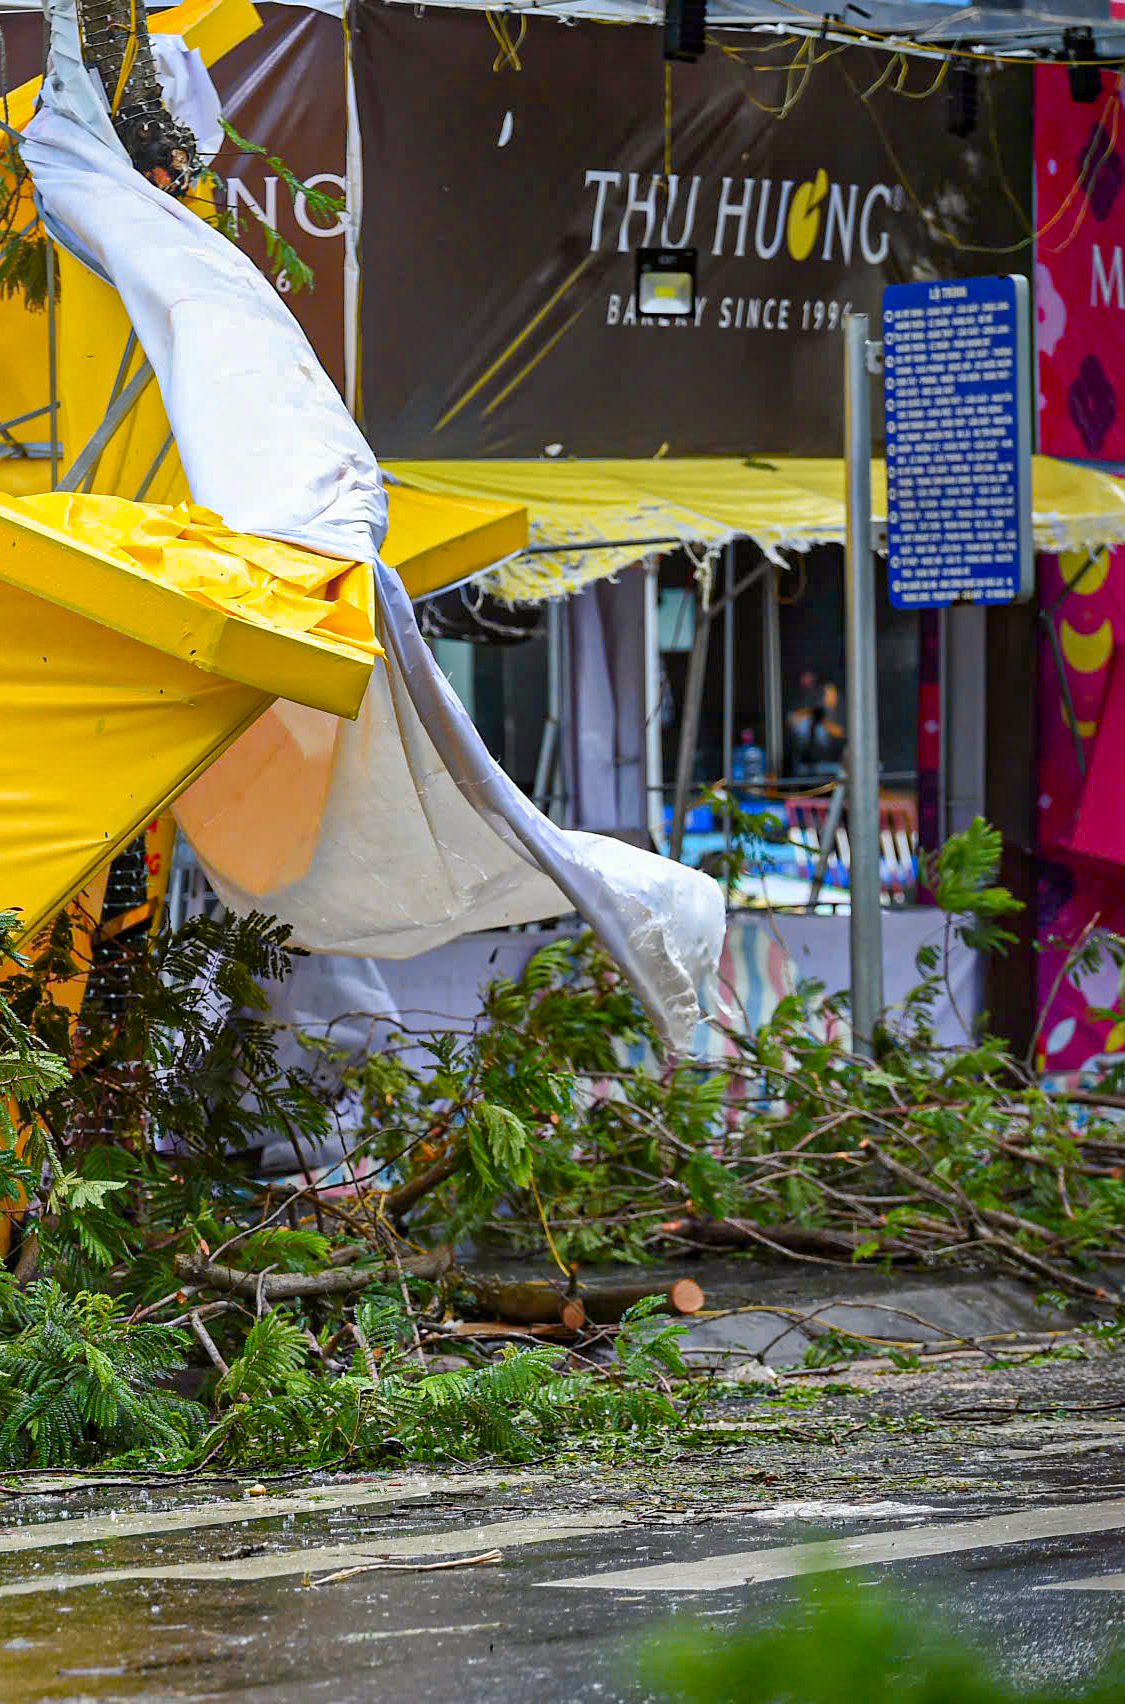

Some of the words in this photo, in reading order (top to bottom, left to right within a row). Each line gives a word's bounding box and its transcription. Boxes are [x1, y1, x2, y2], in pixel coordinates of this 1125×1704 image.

[585, 169, 701, 253] THU
[606, 293, 708, 327] BAY
[718, 296, 791, 330] SINCE
